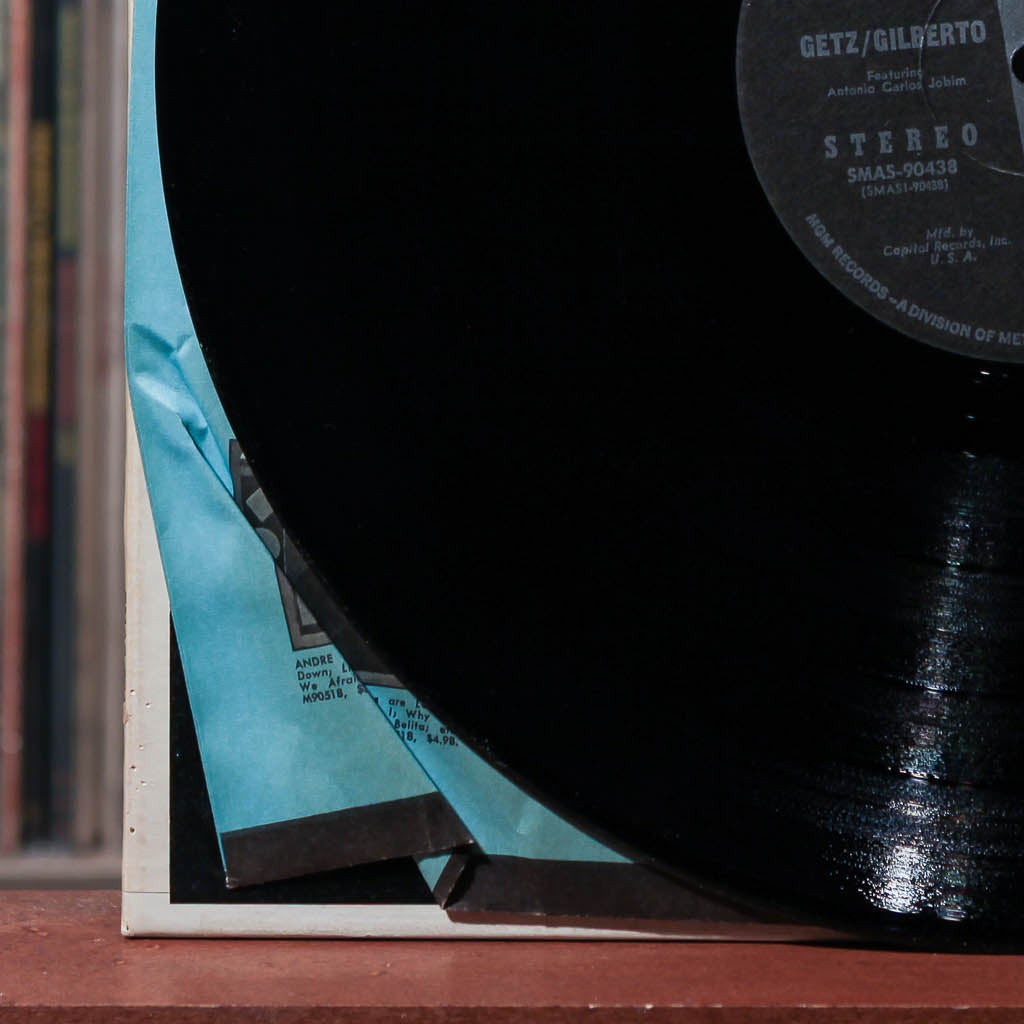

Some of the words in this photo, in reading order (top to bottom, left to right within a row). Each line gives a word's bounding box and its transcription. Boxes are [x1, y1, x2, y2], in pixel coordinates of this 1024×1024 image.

[799, 20, 988, 59] GETZ/GILBERTO
[881, 79, 923, 94] Carlos
[928, 75, 967, 90] Jobim
[847, 158, 959, 184] SMAS-90438
[804, 212, 836, 249] MGM
[831, 244, 890, 301] RECORDS
[907, 303, 972, 339] DIVISION
[974, 327, 999, 343] OF
[295, 654, 334, 670] ANDRE
[297, 669, 332, 681] Down;
[300, 682, 318, 692] We
[302, 687, 348, 705] M90518,
[388, 697, 406, 707] are
[406, 709, 431, 722] Why
